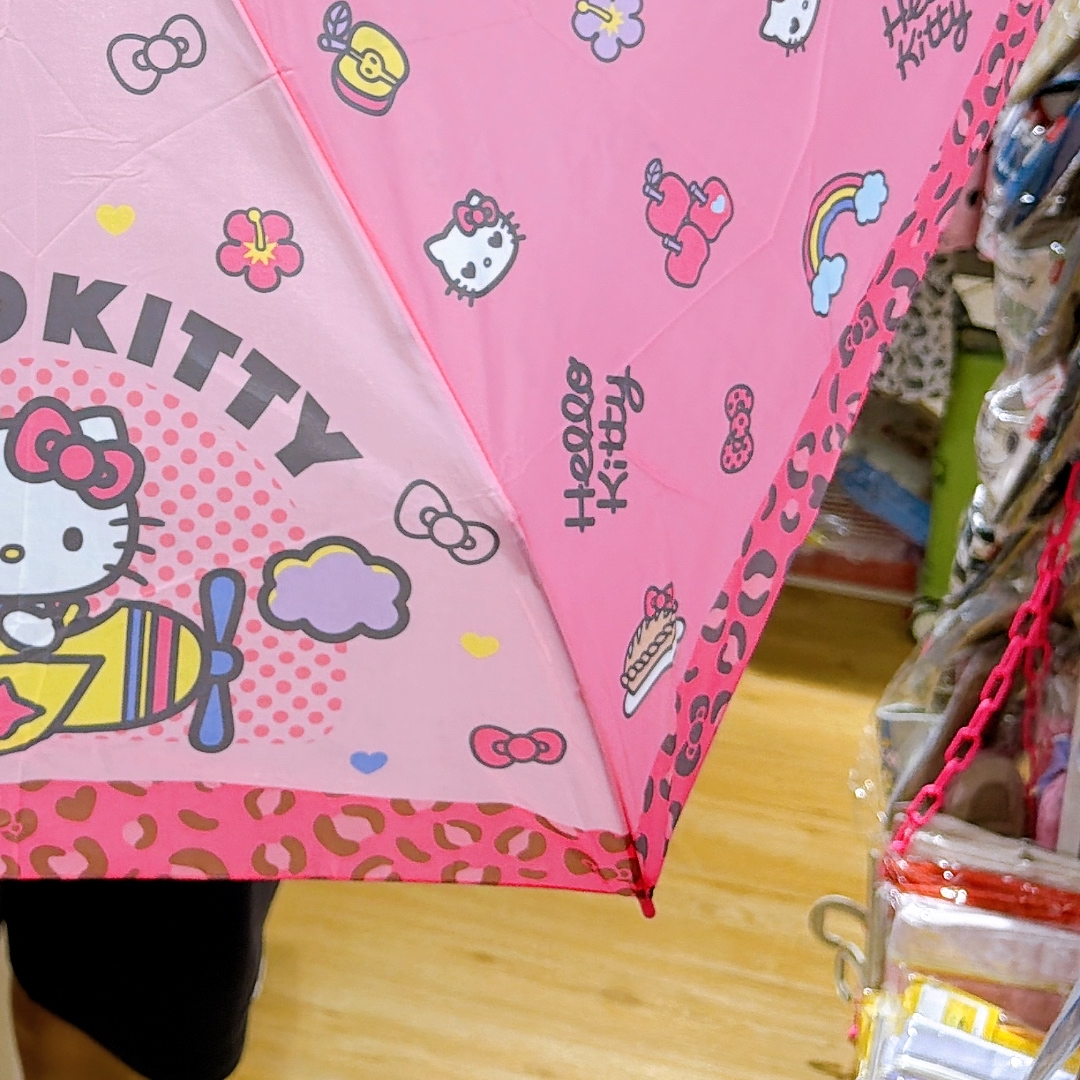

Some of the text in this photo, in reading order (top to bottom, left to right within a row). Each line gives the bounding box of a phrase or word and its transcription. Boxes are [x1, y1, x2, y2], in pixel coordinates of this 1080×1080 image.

[42, 271, 365, 478] KITTY
[560, 355, 597, 533] Hello
[596, 365, 646, 514] Kitty
